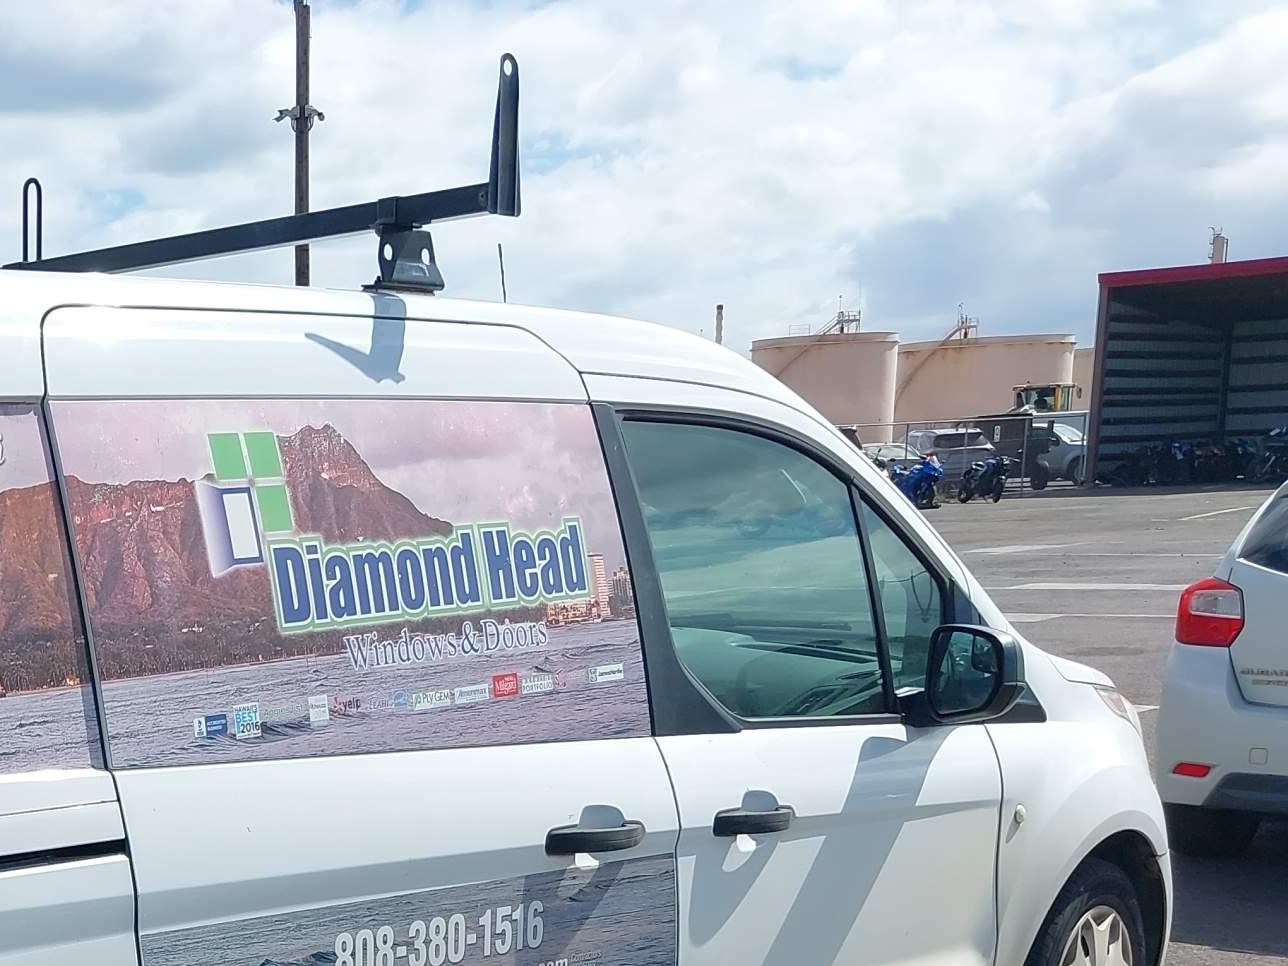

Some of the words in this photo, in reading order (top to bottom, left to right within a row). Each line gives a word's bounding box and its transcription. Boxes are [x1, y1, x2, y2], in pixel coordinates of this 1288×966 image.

[272, 530, 482, 626] Diamond
[481, 523, 588, 601] Head
[522, 680, 553, 692] PORTFOLIO
[343, 697, 361, 713] yelp
[235, 711, 258, 723] BEST
[240, 721, 260, 734] 2016
